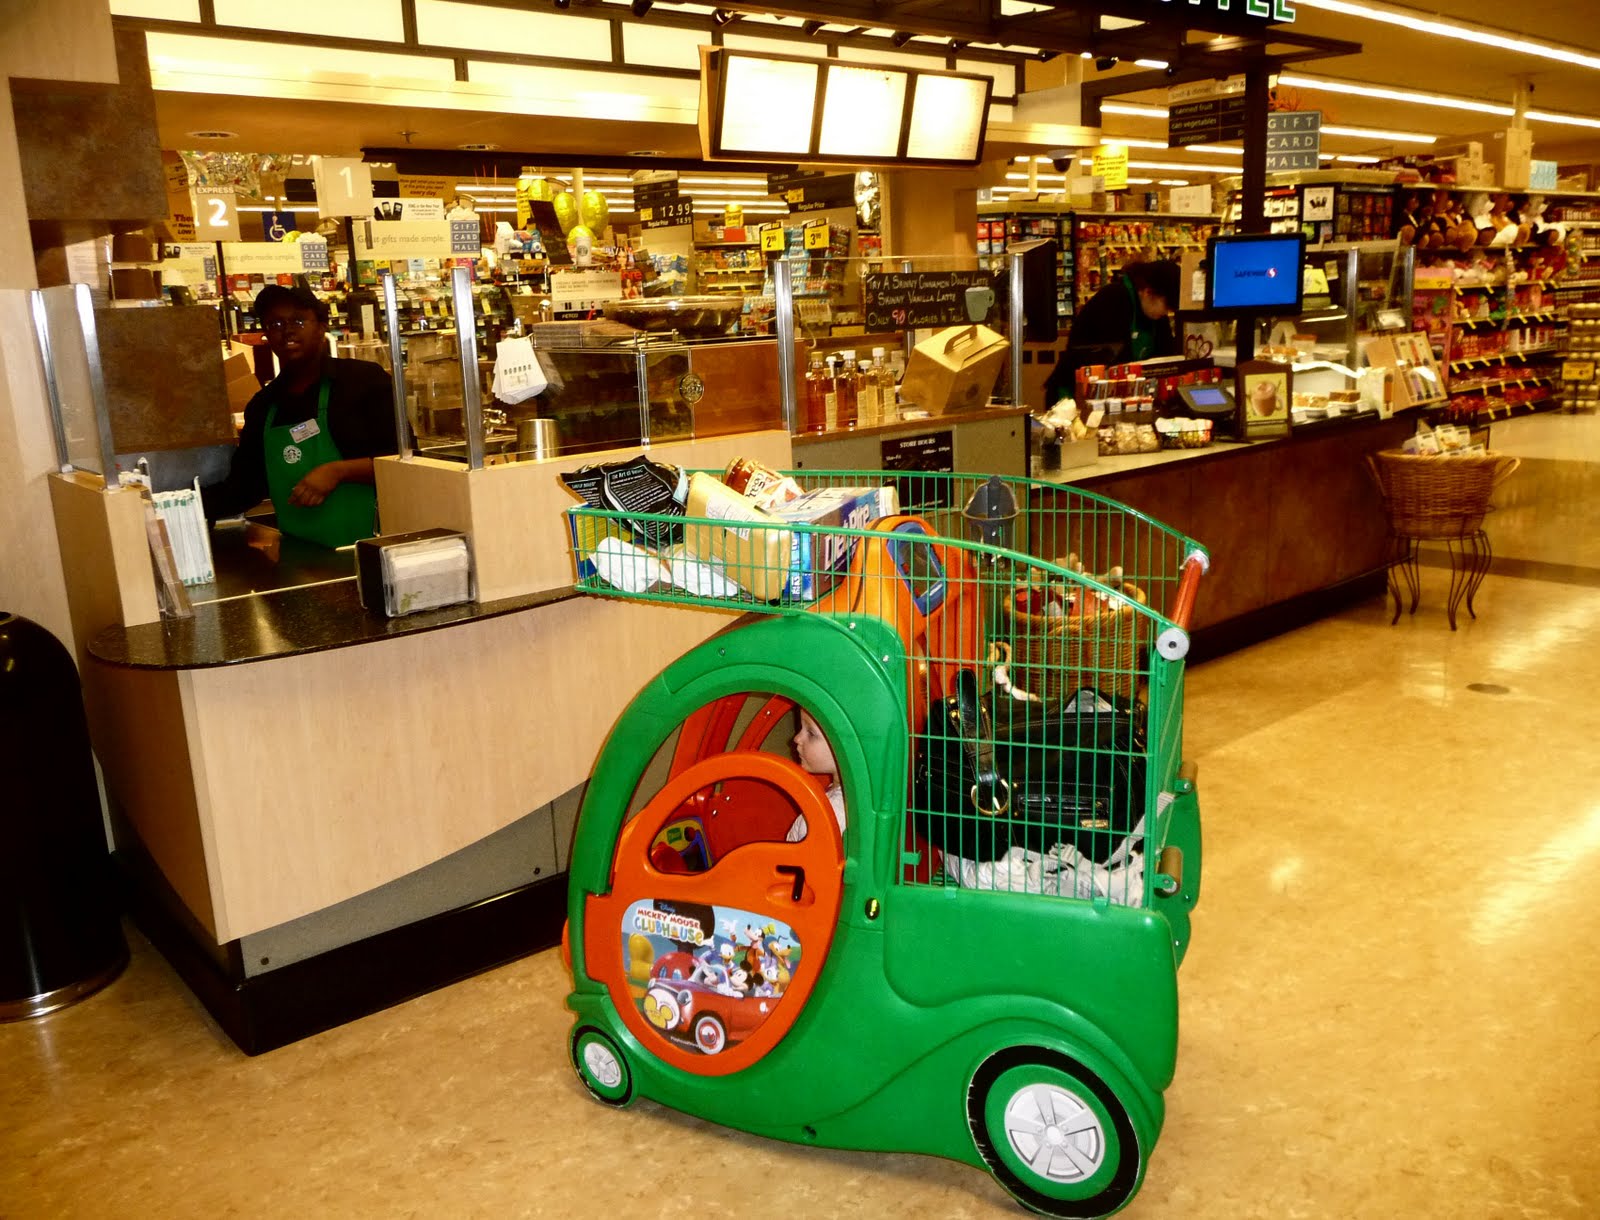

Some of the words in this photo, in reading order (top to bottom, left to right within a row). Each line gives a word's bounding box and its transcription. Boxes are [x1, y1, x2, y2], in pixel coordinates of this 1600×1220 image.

[1184, 118, 1217, 129] vegetables
[1268, 117, 1314, 129] GIFT
[1267, 136, 1313, 148] CARD
[1266, 155, 1311, 167] MALL
[339, 166, 353, 198] 1
[208, 198, 229, 227] 2
[399, 234, 420, 243] made
[1234, 270, 1266, 279] SAFEWAY
[883, 275, 890, 290] A
[900, 441, 917, 449] STORE
[637, 908, 668, 921] MICKEY
[669, 915, 699, 928] MOUSE
